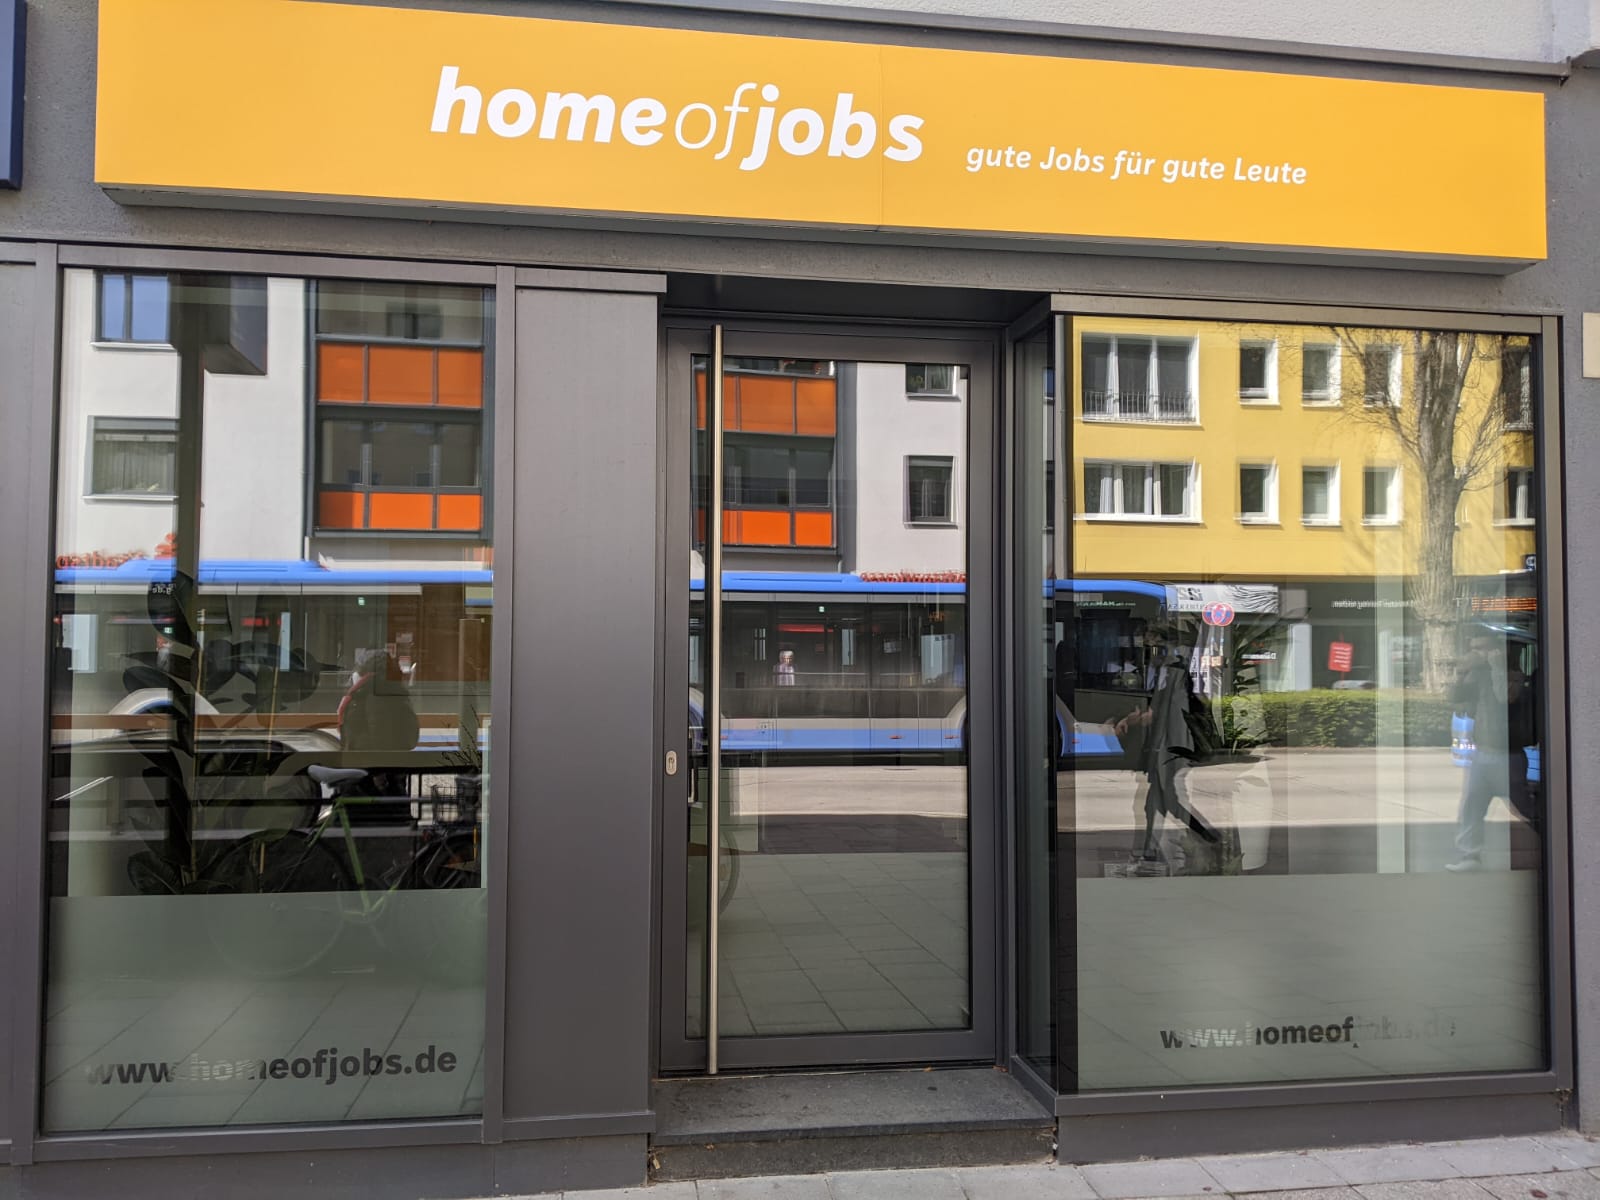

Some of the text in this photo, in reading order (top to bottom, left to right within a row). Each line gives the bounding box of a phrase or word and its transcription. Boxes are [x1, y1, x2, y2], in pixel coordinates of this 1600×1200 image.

[966, 146, 1307, 184] gute Jobs für gute Leute
[1159, 1013, 1456, 1049] www.homeofbs.d
[86, 1045, 457, 1085] www.homeofjobs.de
